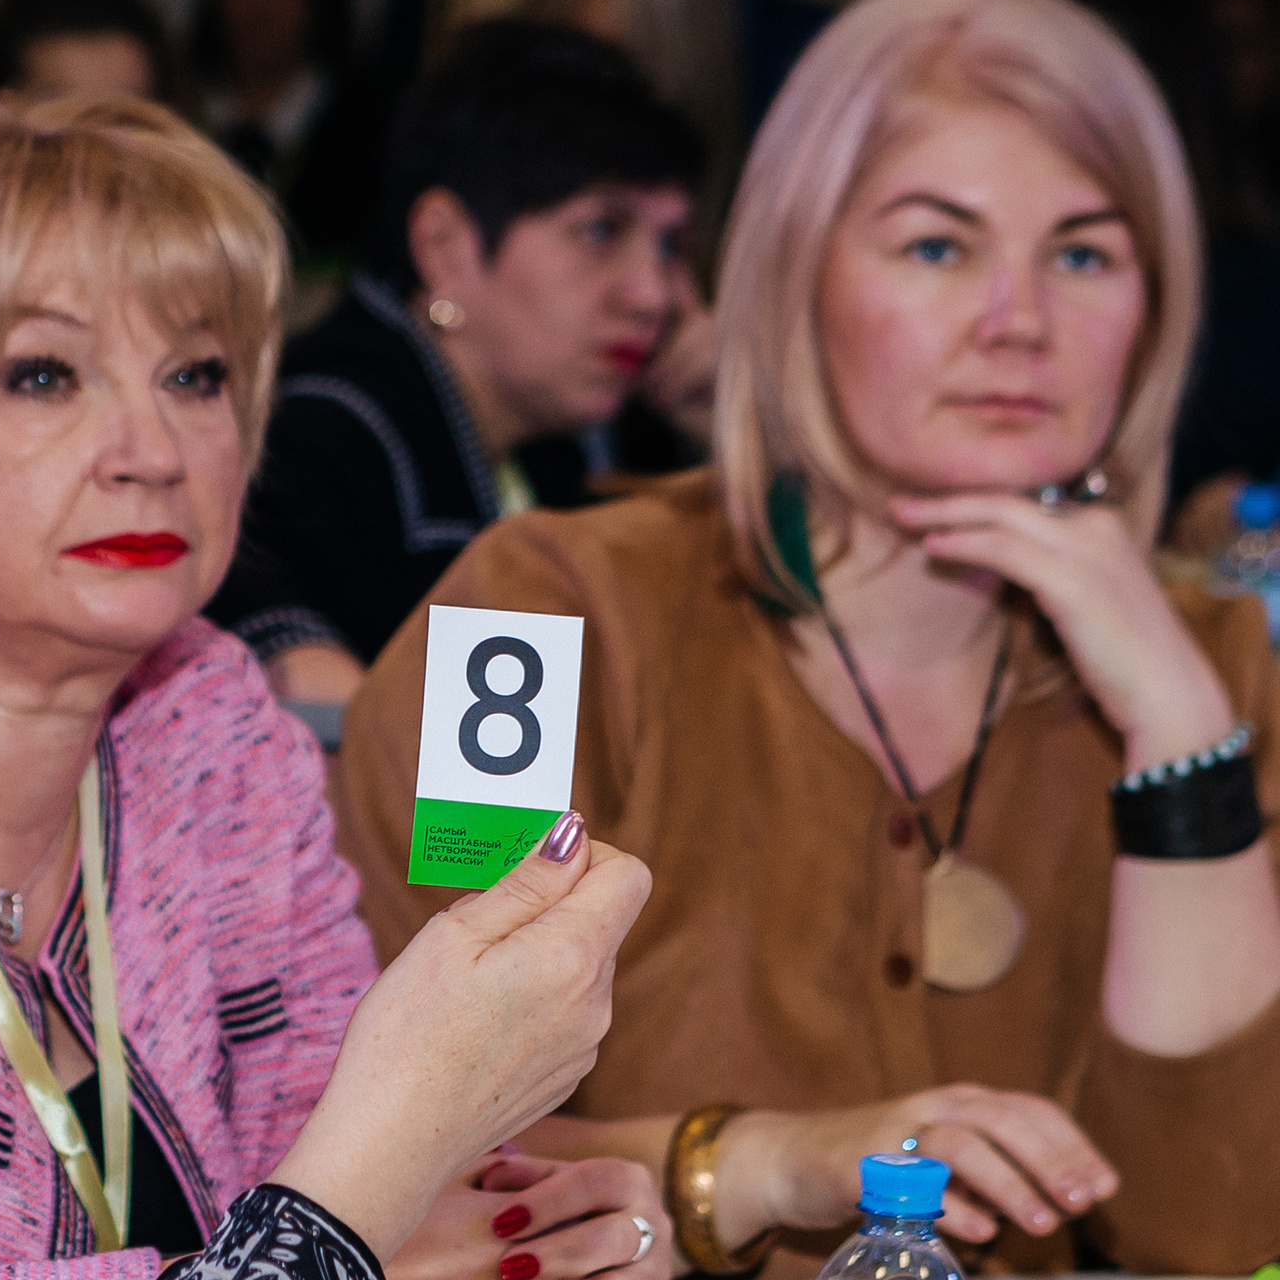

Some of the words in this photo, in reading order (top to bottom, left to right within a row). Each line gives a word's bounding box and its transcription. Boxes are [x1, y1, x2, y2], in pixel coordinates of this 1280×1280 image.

[458, 635, 544, 776] 8
[429, 825, 467, 837] САМЫЙ
[428, 835, 502, 849] МАСШТАБНЫЙ
[427, 845, 493, 858] НЕТВОРКИНГ
[426, 853, 433, 862] В
[435, 854, 484, 867] ХАКАСИИ
